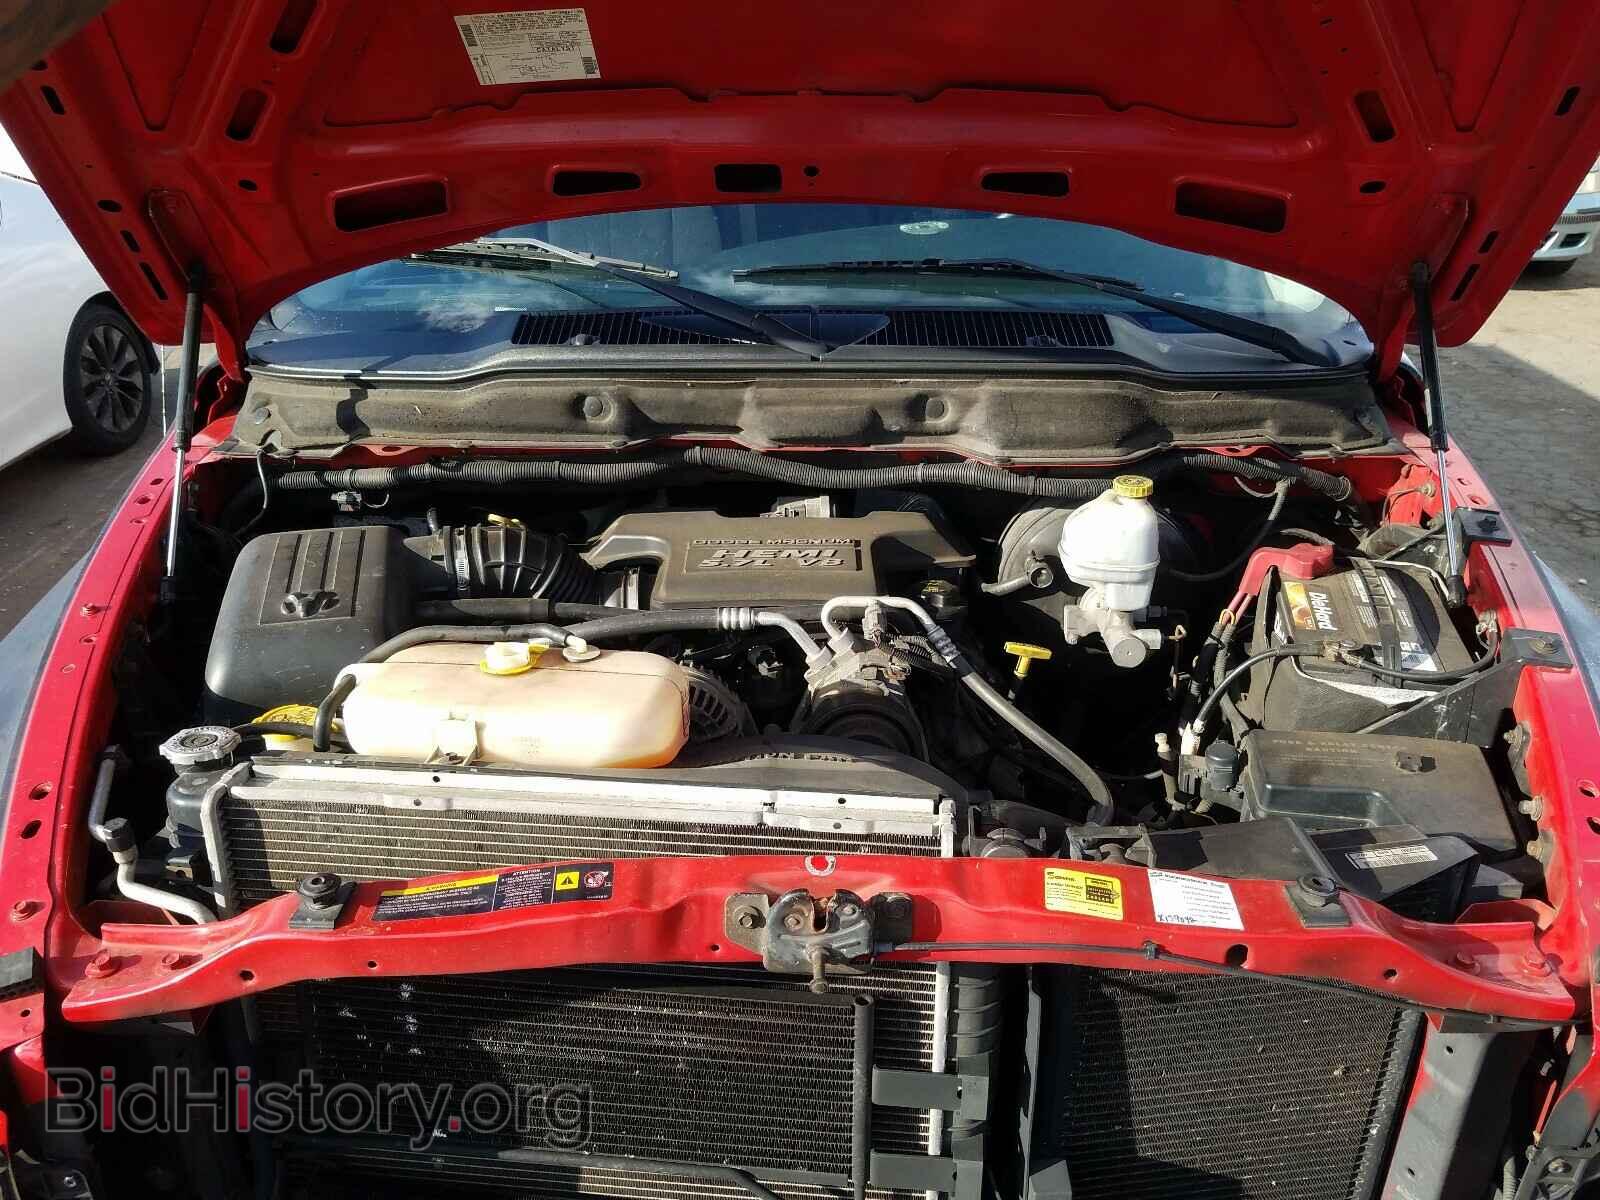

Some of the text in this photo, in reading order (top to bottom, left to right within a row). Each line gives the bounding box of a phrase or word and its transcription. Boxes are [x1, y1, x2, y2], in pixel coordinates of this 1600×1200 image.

[711, 549, 839, 559] HEMI
[697, 559, 846, 568] 5.7L V8
[1308, 591, 1338, 630] DieHard
